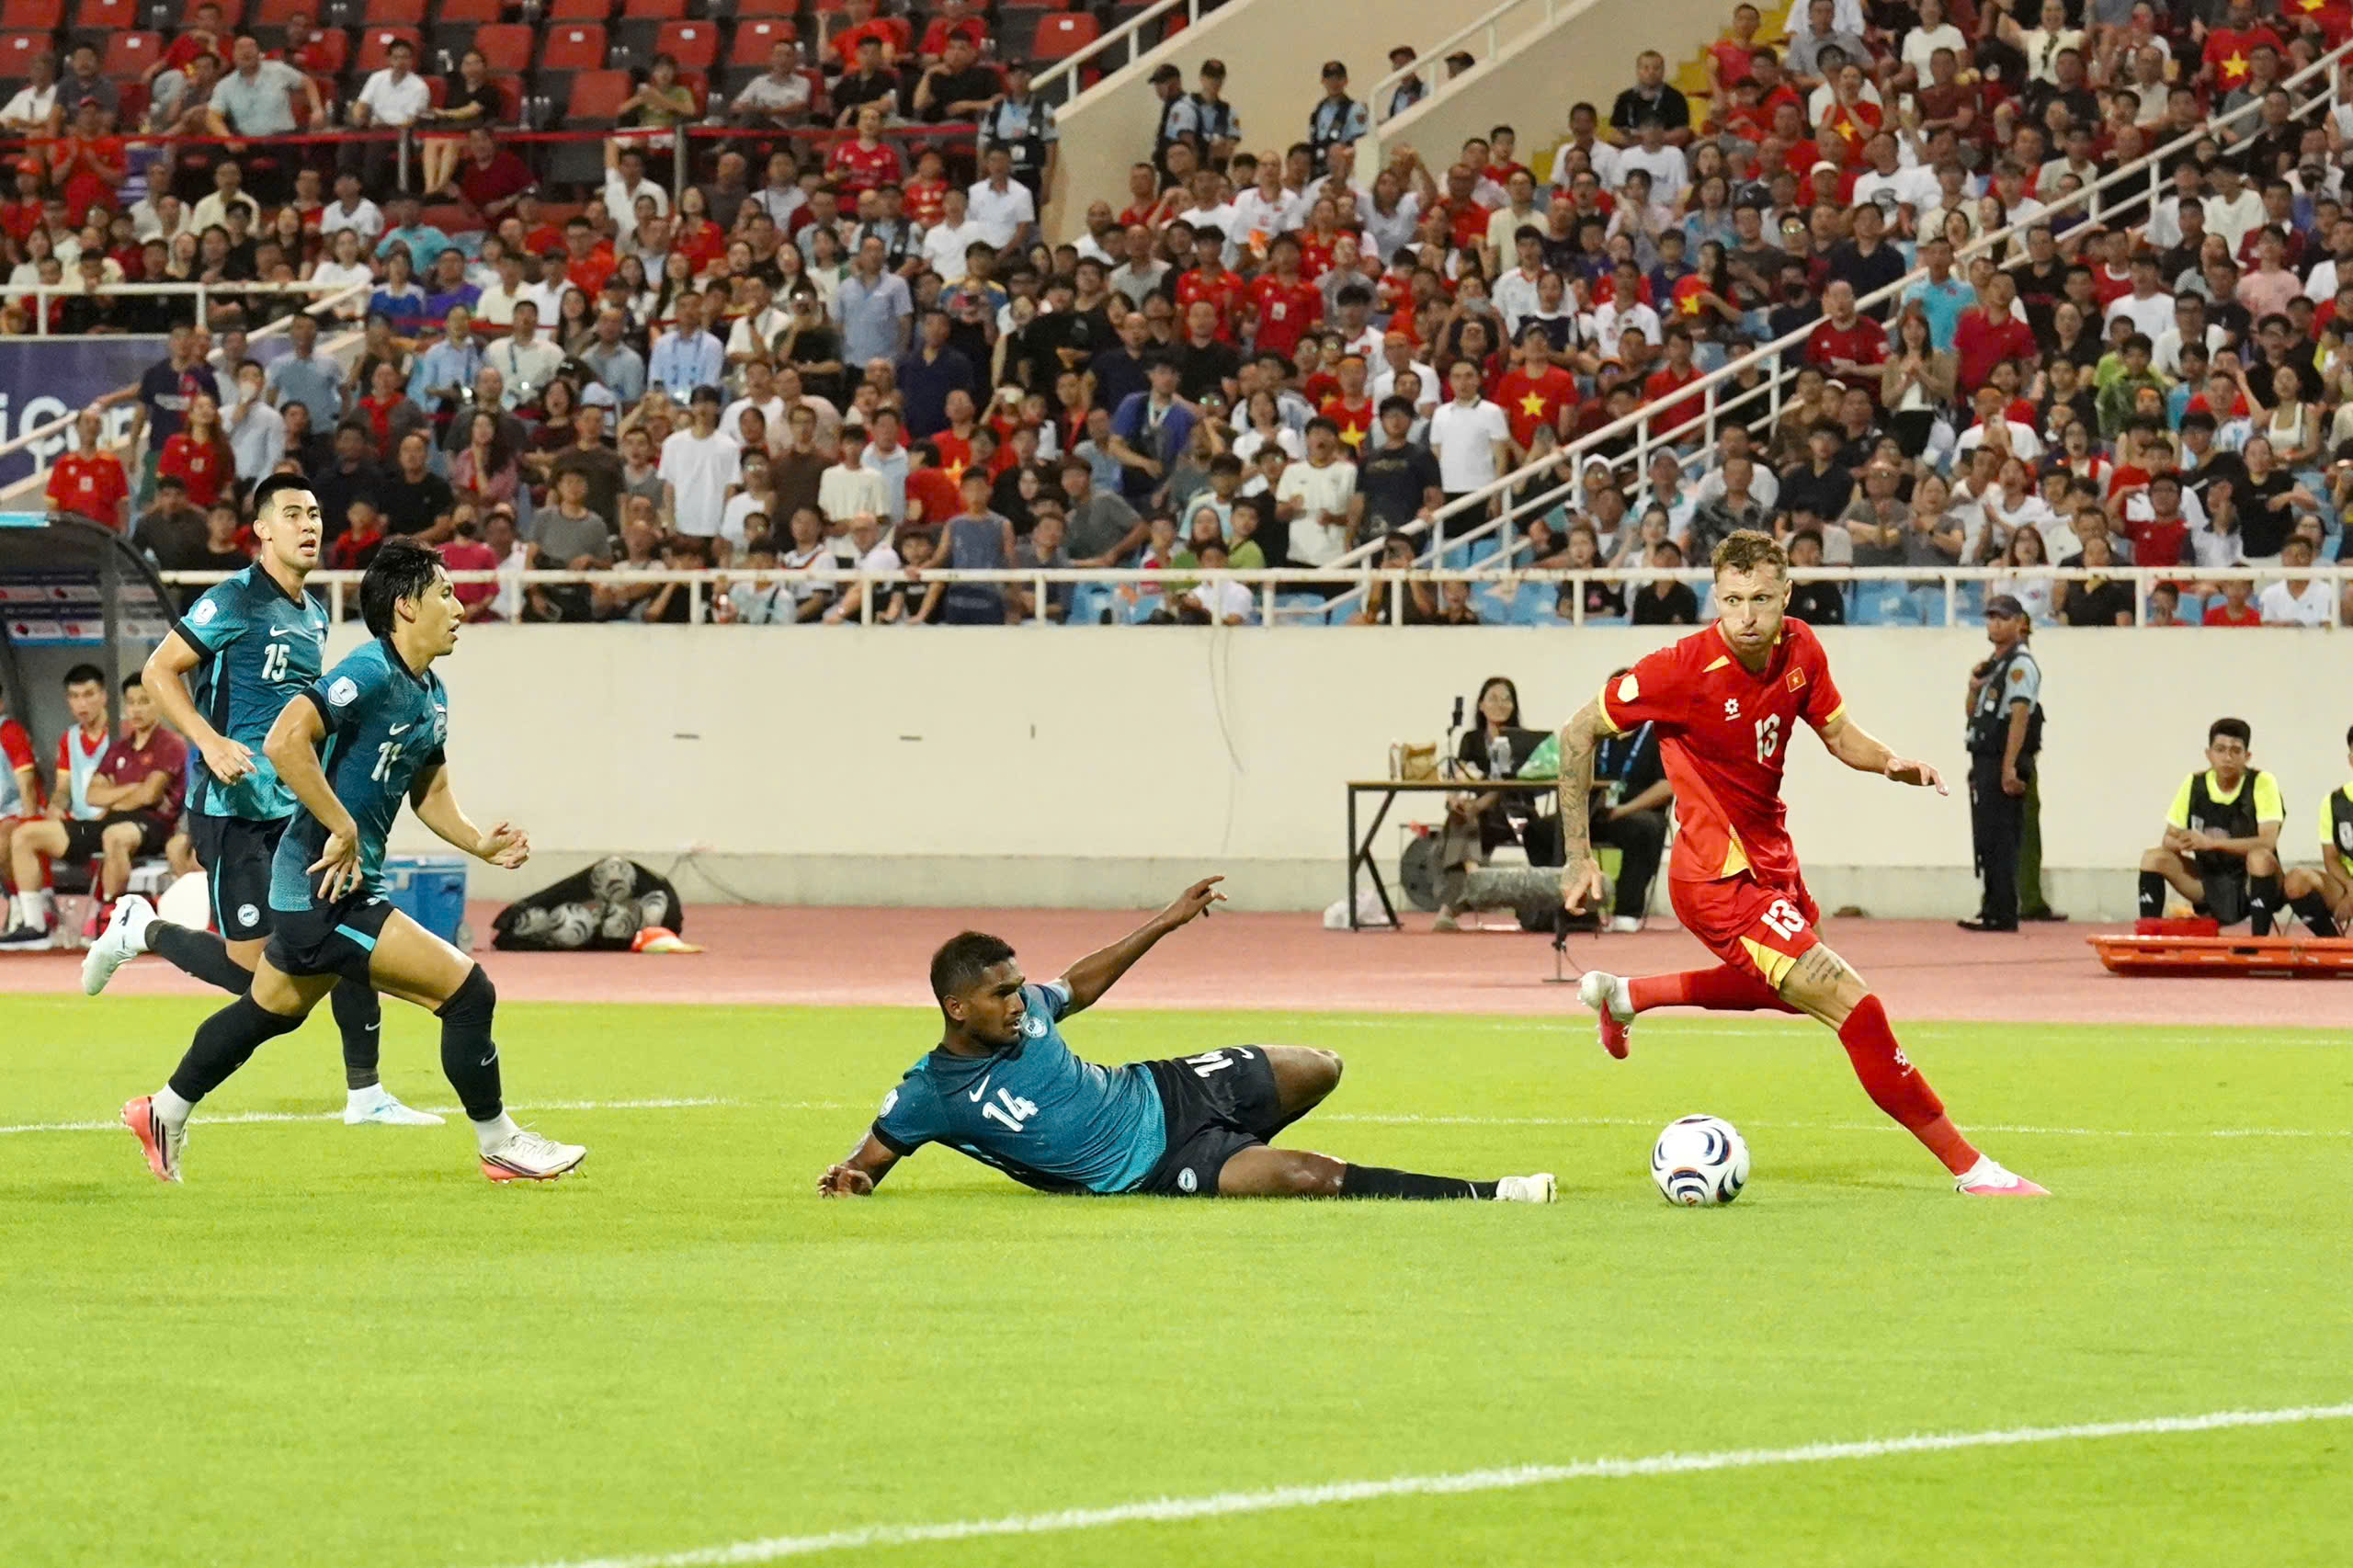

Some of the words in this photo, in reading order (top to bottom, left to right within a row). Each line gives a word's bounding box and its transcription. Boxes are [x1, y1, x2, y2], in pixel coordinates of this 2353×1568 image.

[261, 642, 290, 683] 15
[1755, 712, 1780, 765] 13
[1760, 899, 1805, 942] 13
[982, 1087, 1040, 1132] 14
